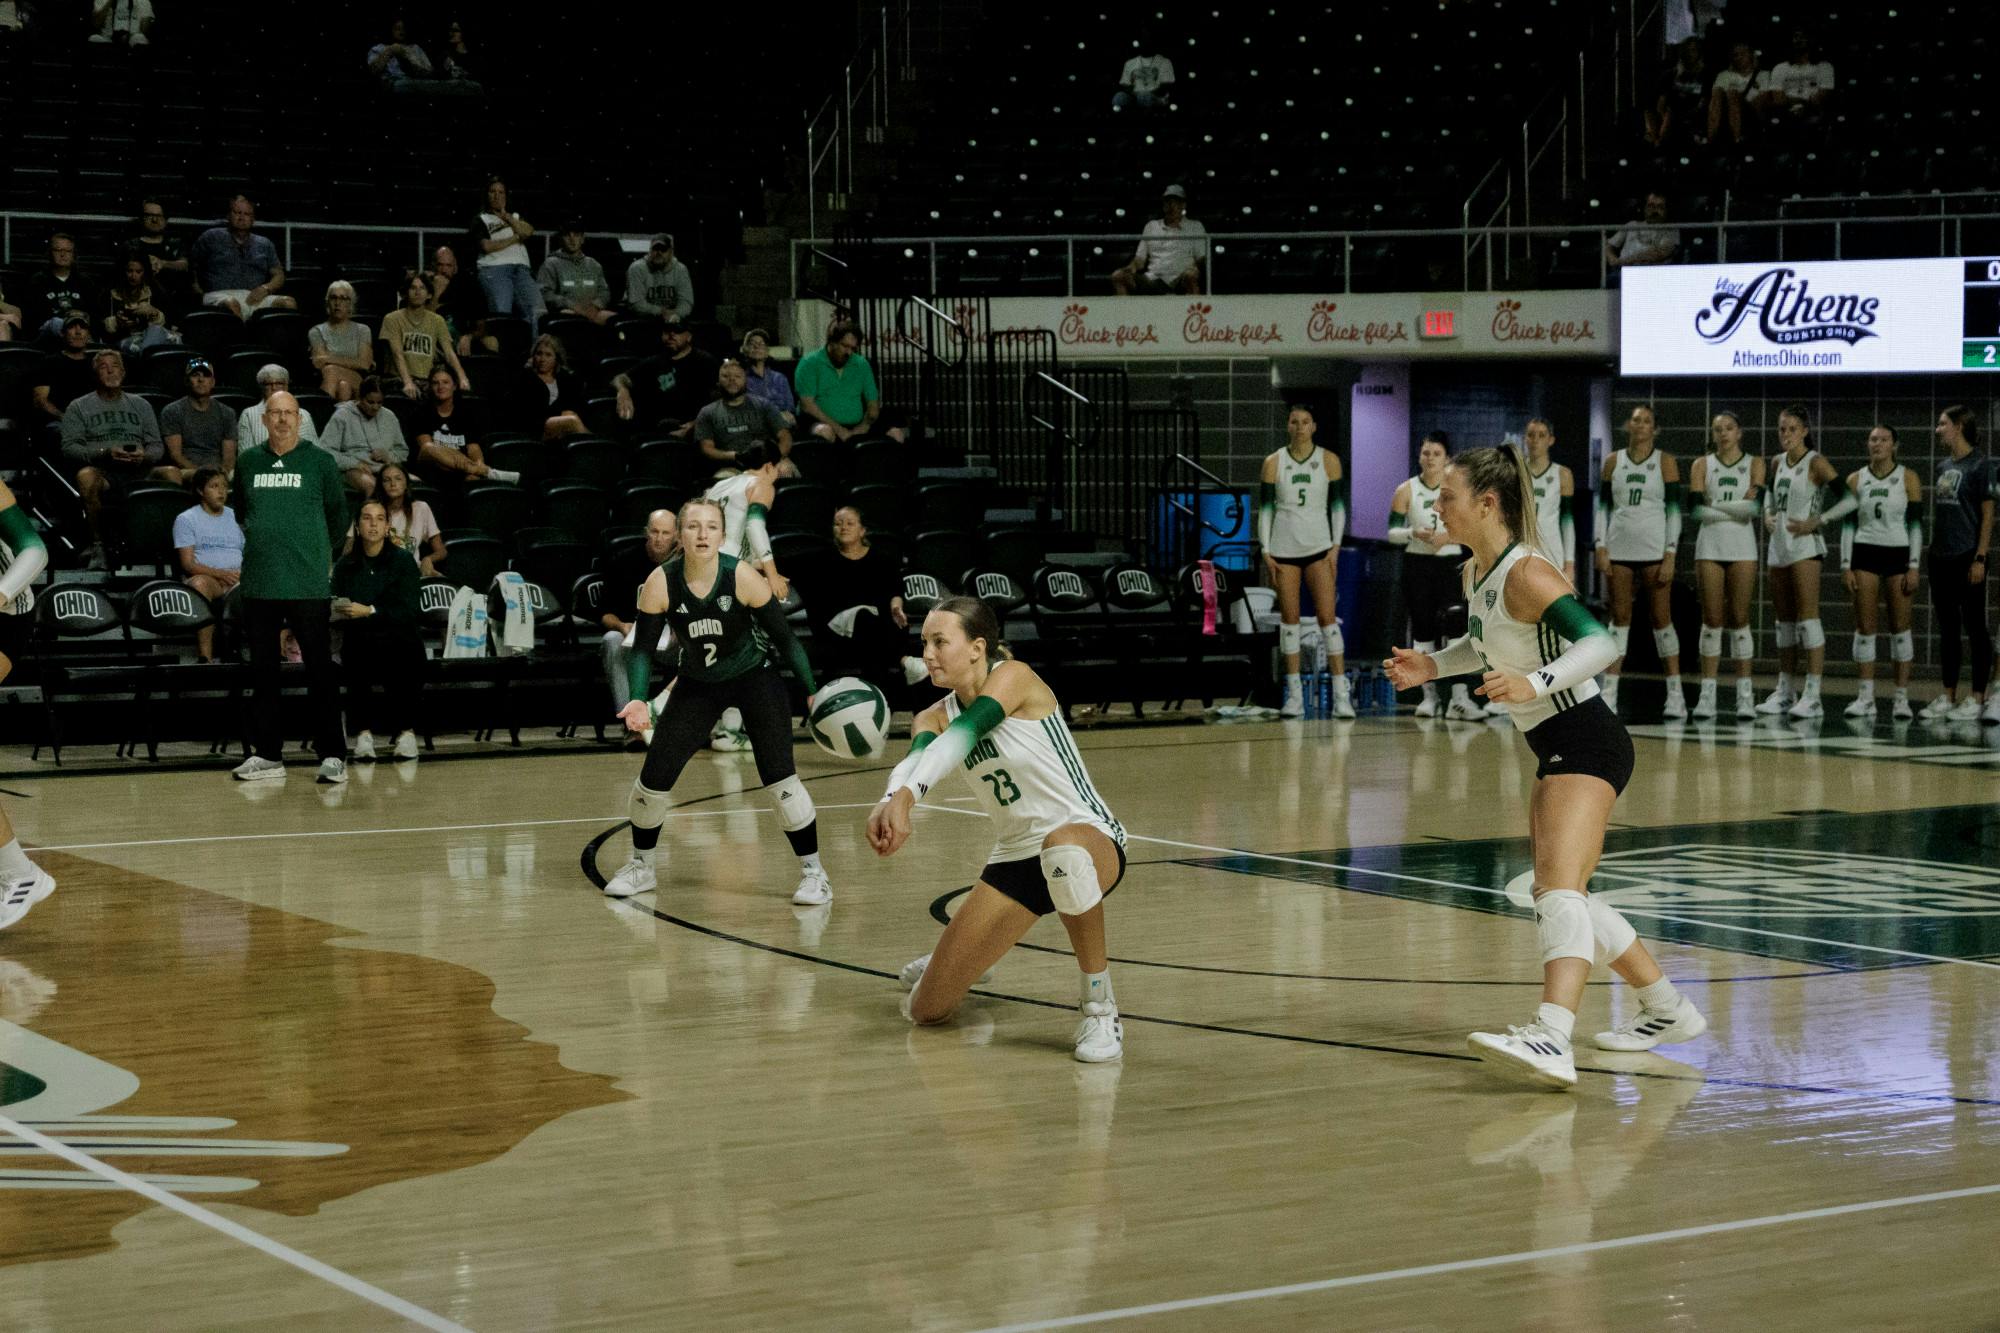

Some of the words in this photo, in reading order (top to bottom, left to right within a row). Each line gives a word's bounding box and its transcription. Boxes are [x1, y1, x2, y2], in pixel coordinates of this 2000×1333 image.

[1695, 268, 1879, 344] Athens
[1060, 313, 1159, 347] Chick-fil-A
[1183, 312, 1283, 346] Chick-fil-A
[1307, 311, 1408, 345] Chick-fil-A
[1425, 310, 1454, 336] EXIT
[1492, 308, 1596, 344] Chick-fil-A
[1776, 328, 1823, 343] COUNTY
[1825, 327, 1857, 339] OHIO
[1732, 350, 1842, 367] AthensOhio.com
[1983, 344, 1997, 364] 2
[253, 472, 302, 489] BOBCATS
[1297, 488, 1306, 506] 5
[1628, 488, 1642, 505] 10
[1874, 501, 1882, 519] 6
[975, 572, 1012, 600] OHIO
[1047, 571, 1084, 598] OHIO
[1116, 569, 1153, 596] OHIO
[53, 590, 99, 620] OHIO
[148, 588, 193, 618] OHIO
[420, 584, 457, 612] OHIO
[688, 618, 724, 639] OHIO
[703, 642, 718, 668] 2
[981, 768, 1022, 806] 23
